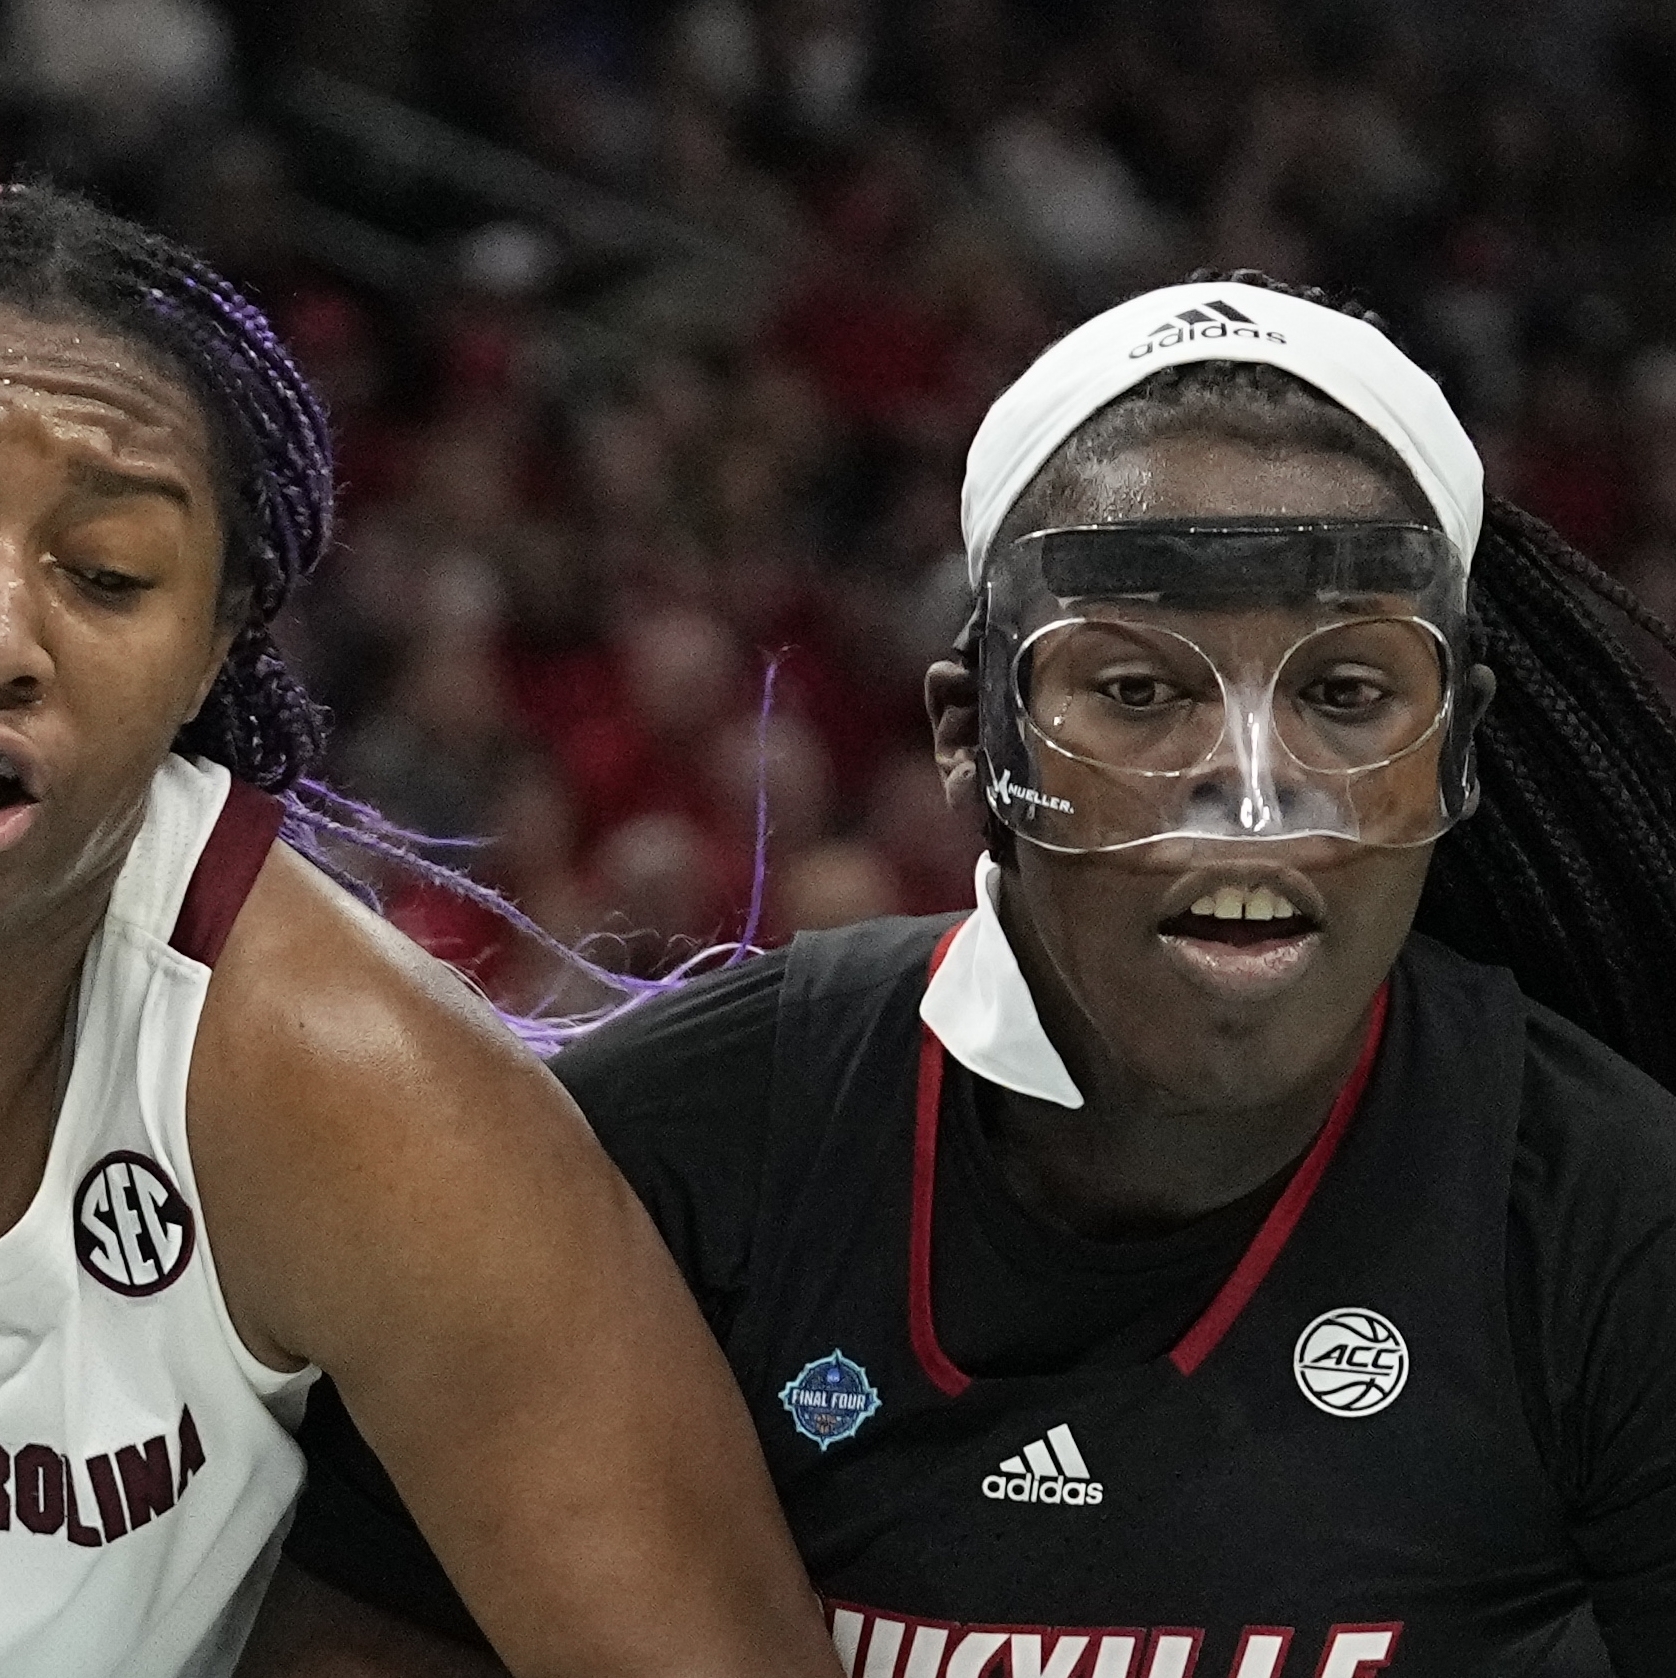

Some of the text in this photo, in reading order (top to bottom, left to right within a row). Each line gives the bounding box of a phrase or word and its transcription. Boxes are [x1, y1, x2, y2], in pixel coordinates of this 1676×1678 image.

[1127, 322, 1288, 359] adidas
[79, 1161, 184, 1287] SEC
[1310, 1343, 1402, 1370] ACC
[791, 1388, 866, 1411] FINAL FOUR
[981, 1471, 1104, 1506] adidas
